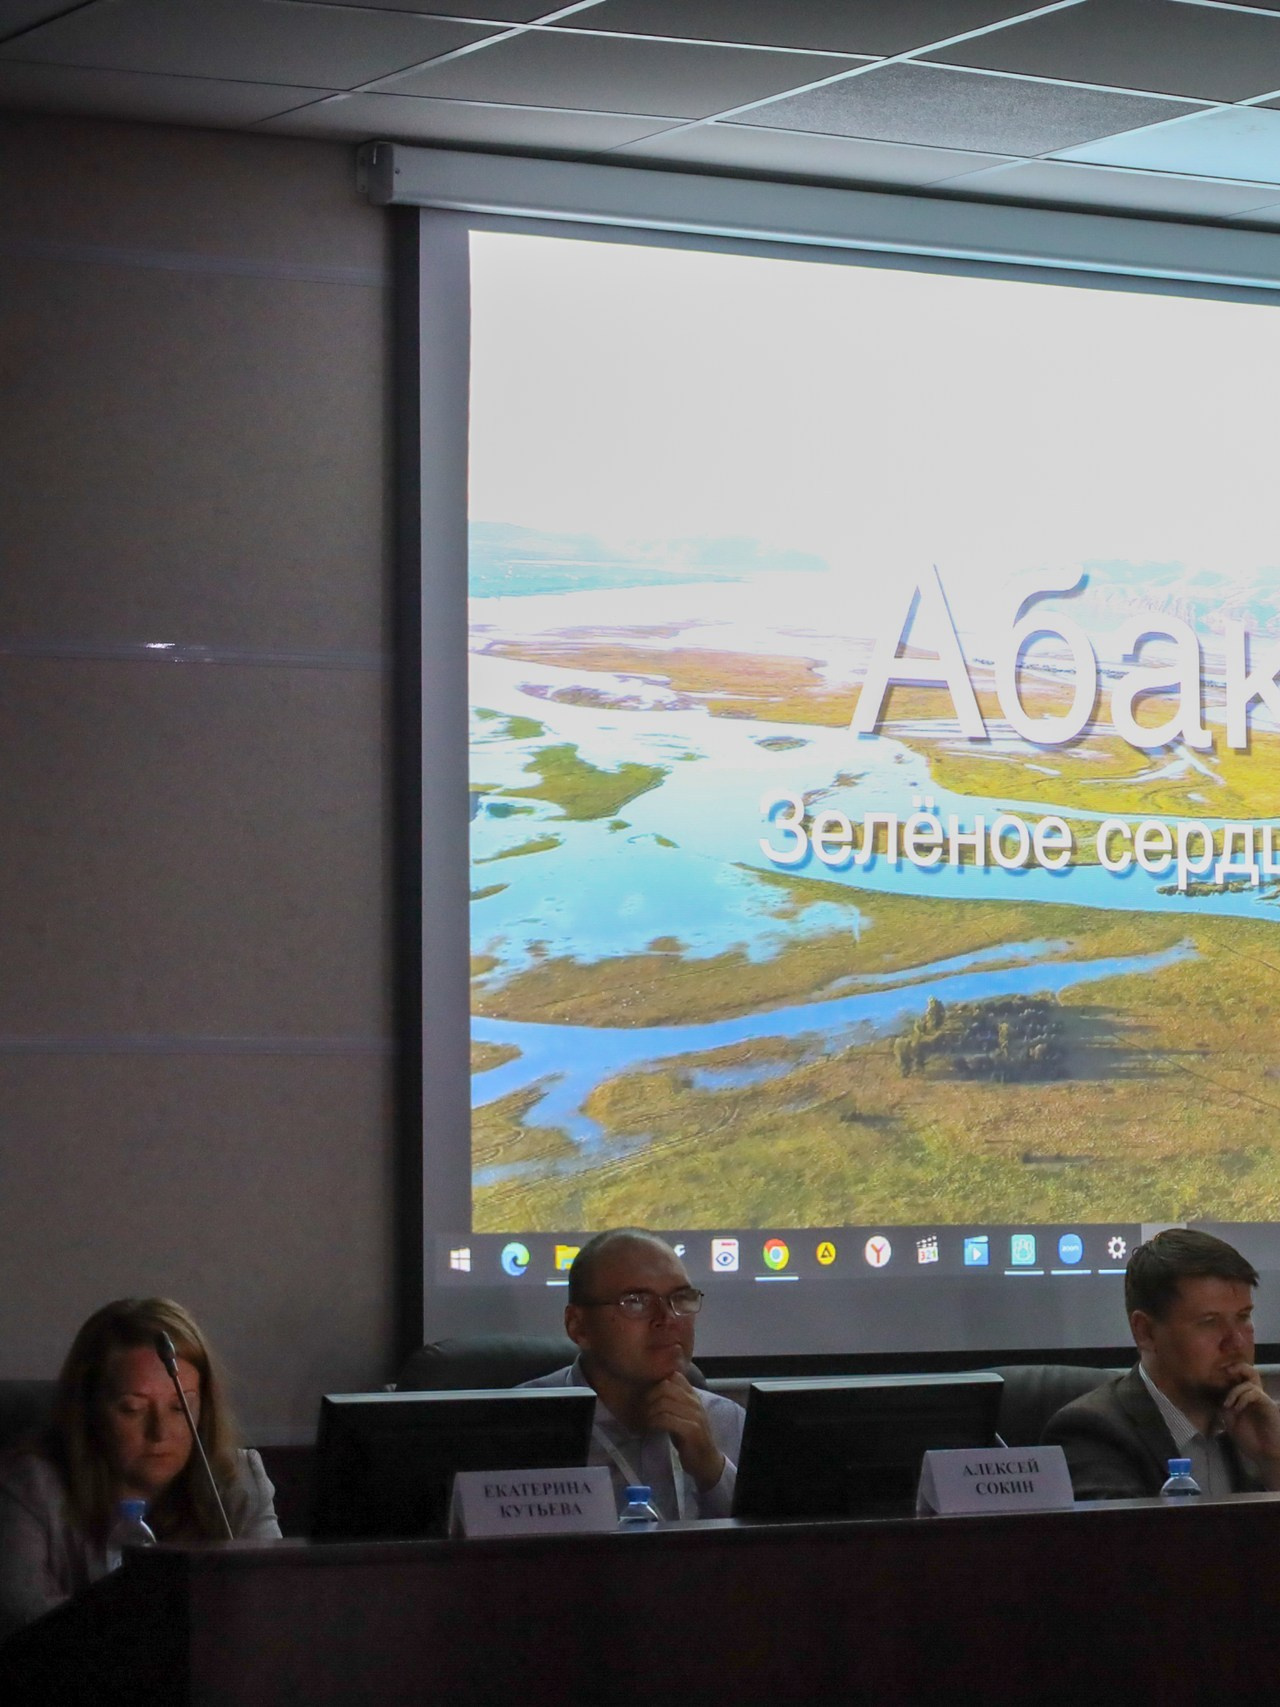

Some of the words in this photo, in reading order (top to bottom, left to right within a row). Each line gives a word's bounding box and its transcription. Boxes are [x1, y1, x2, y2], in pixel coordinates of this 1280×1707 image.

[757, 791, 1074, 872] Зелёное
[962, 1457, 1040, 1477] АЛЕКСЕЙ
[484, 1480, 592, 1498] ЕКАТЕРИНА
[975, 1480, 1035, 1496] СОКИН
[500, 1502, 583, 1519] КУТЬЕВА
